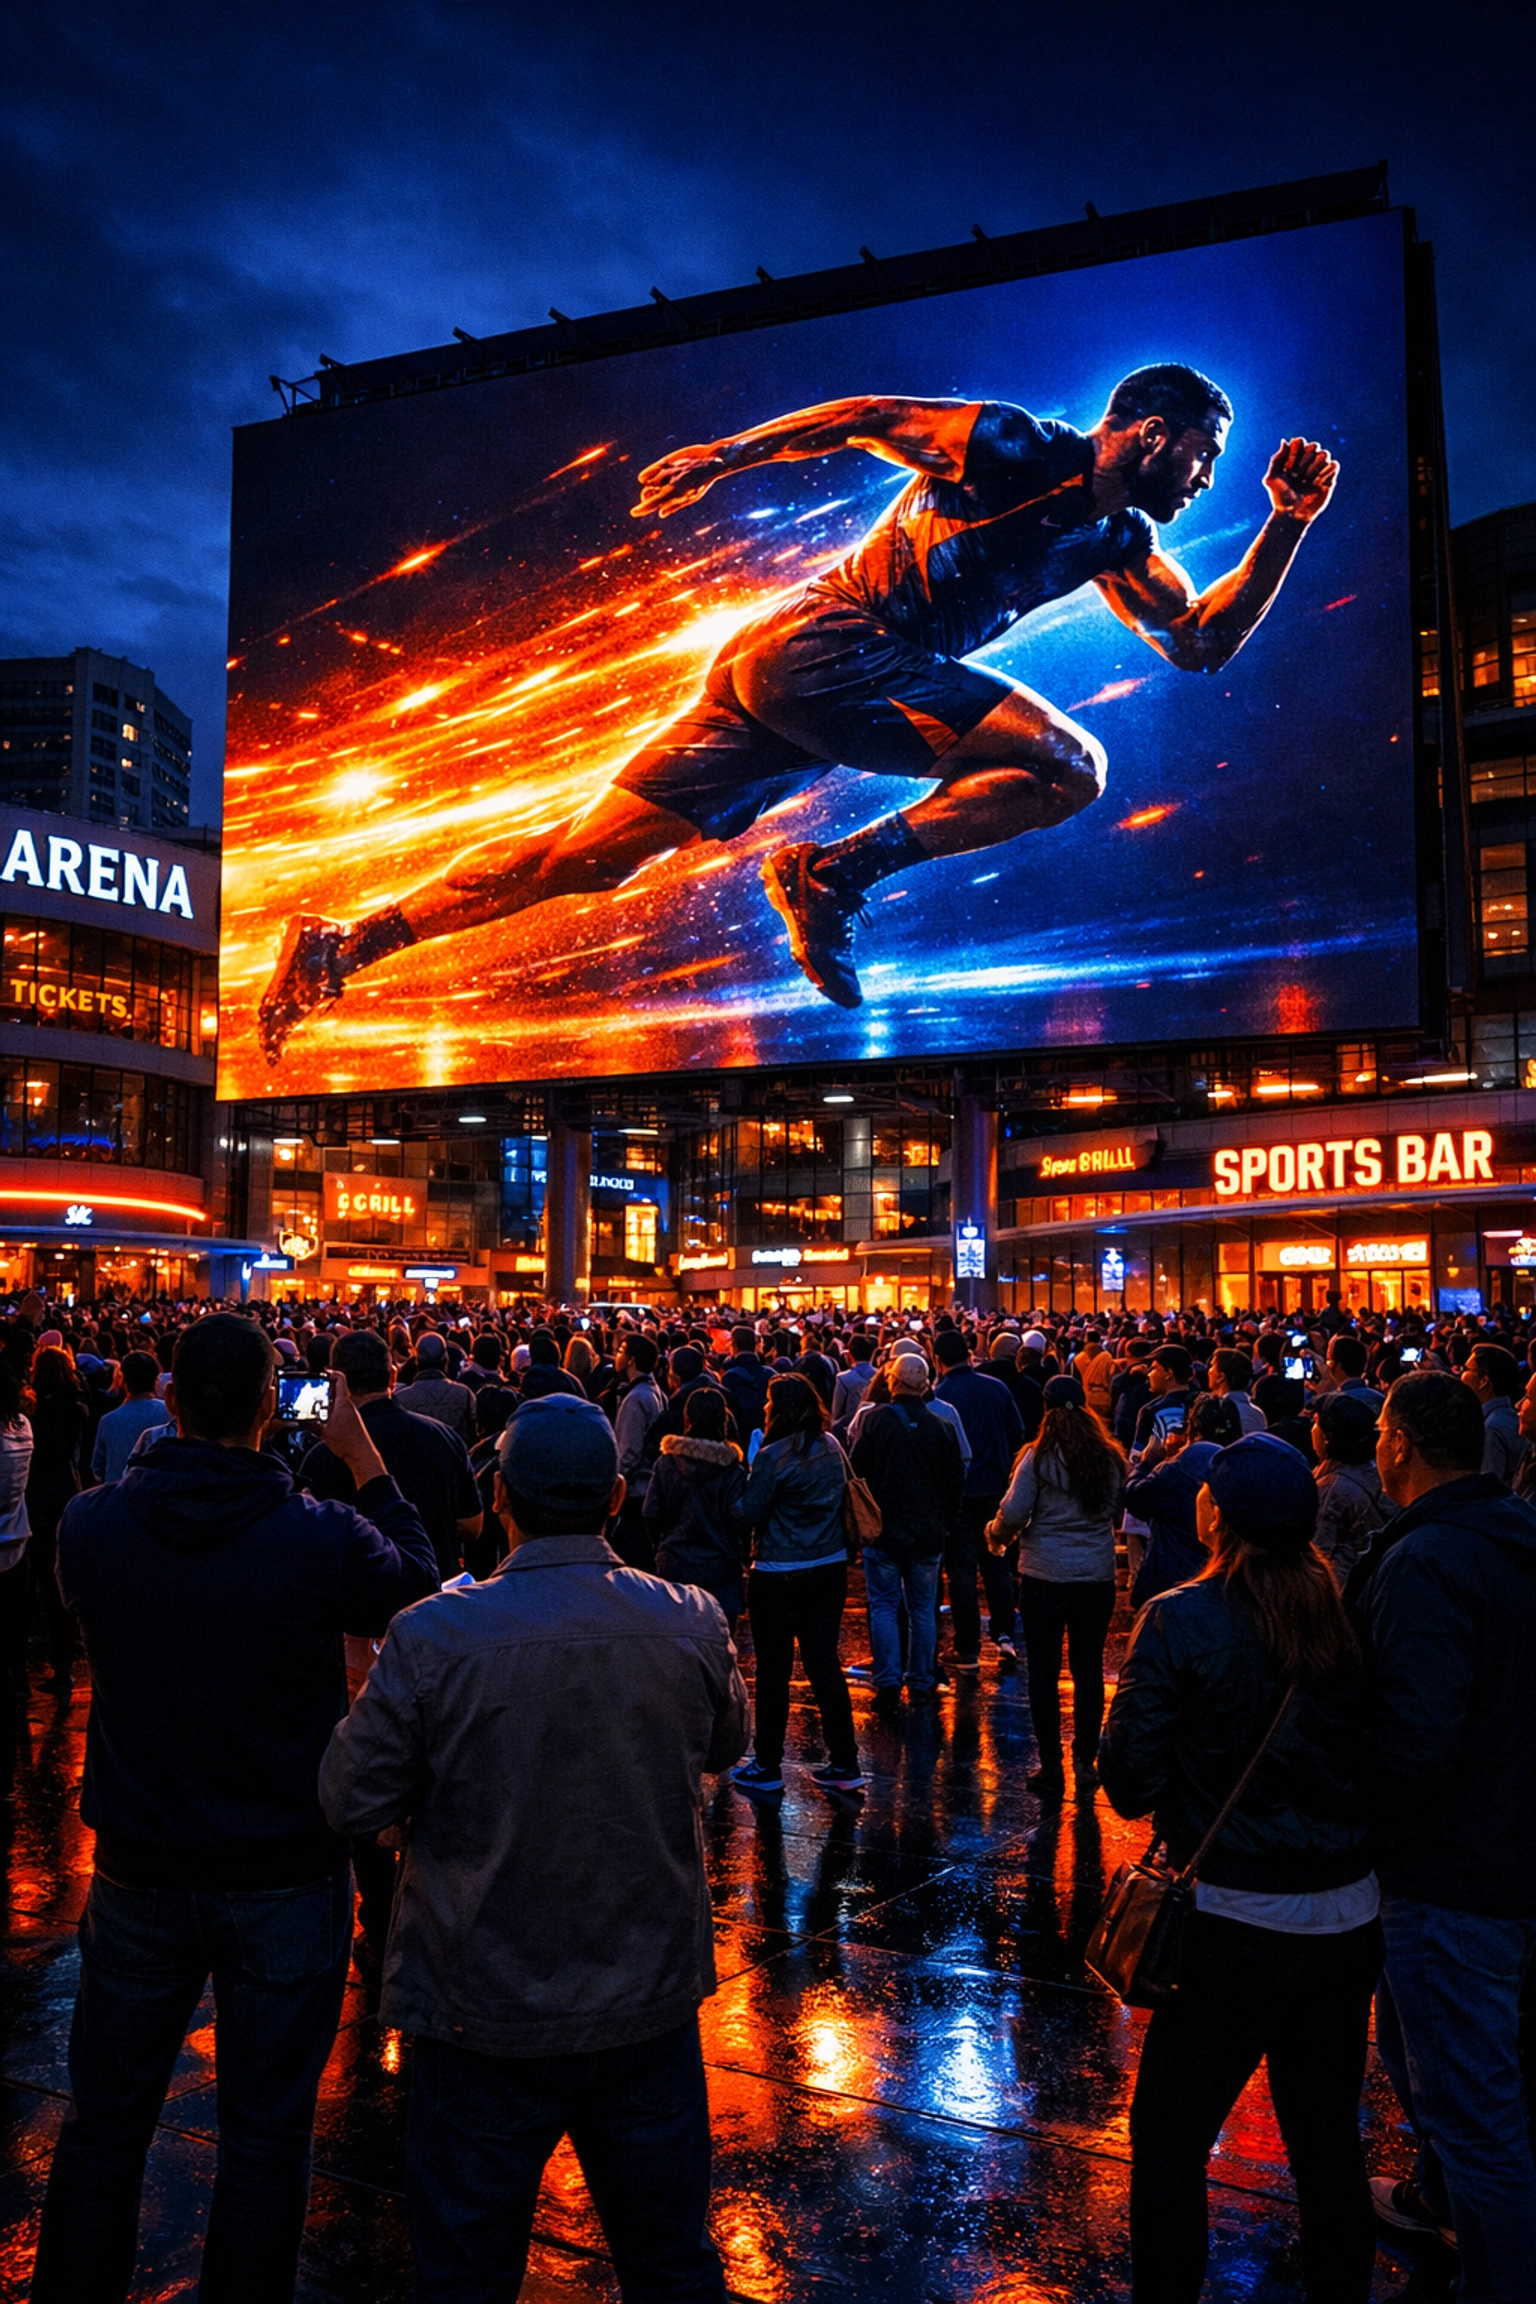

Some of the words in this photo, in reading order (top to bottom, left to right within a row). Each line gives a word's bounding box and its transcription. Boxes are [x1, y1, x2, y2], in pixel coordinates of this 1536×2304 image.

[0, 829, 194, 920] ARENA
[1214, 1138, 1382, 1196] SPORTS
[1397, 1130, 1494, 1184] BAR
